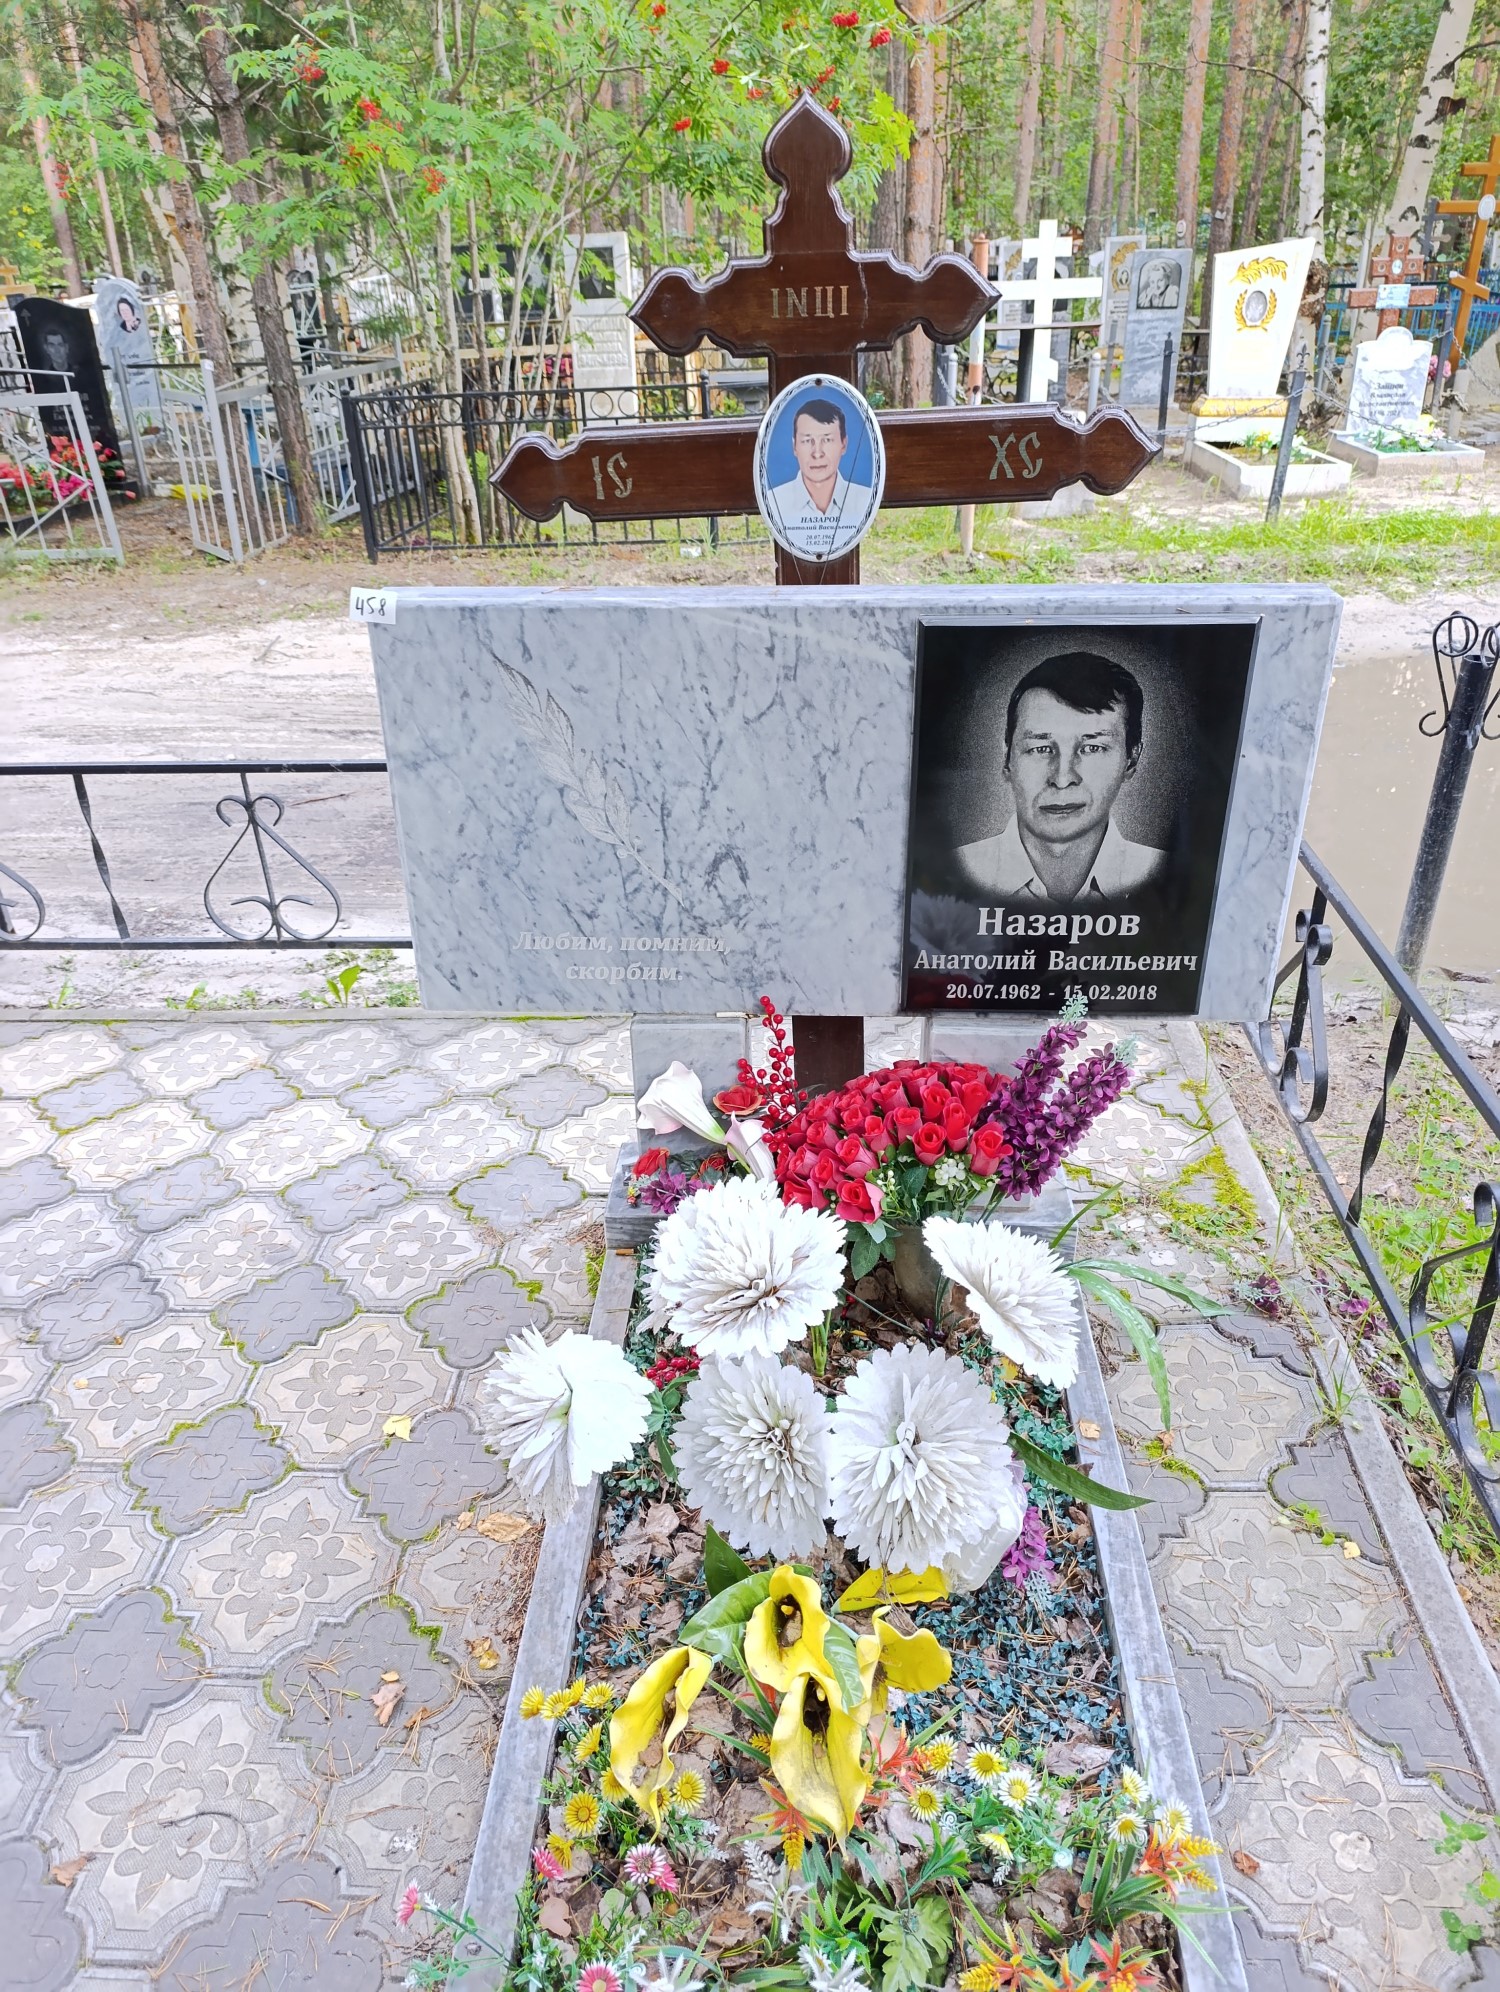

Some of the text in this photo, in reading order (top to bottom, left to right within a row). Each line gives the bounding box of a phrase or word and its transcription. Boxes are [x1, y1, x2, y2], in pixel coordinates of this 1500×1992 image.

[355, 596, 387, 617] 458
[976, 907, 1141, 944] Назаров
[512, 931, 731, 955] Любим, помним,
[913, 949, 1198, 971] Анатолий Васильевич
[565, 962, 683, 985] скорбим.
[946, 983, 1041, 1000] 20.07.1962
[1063, 984, 1158, 1000] 1502.2018
